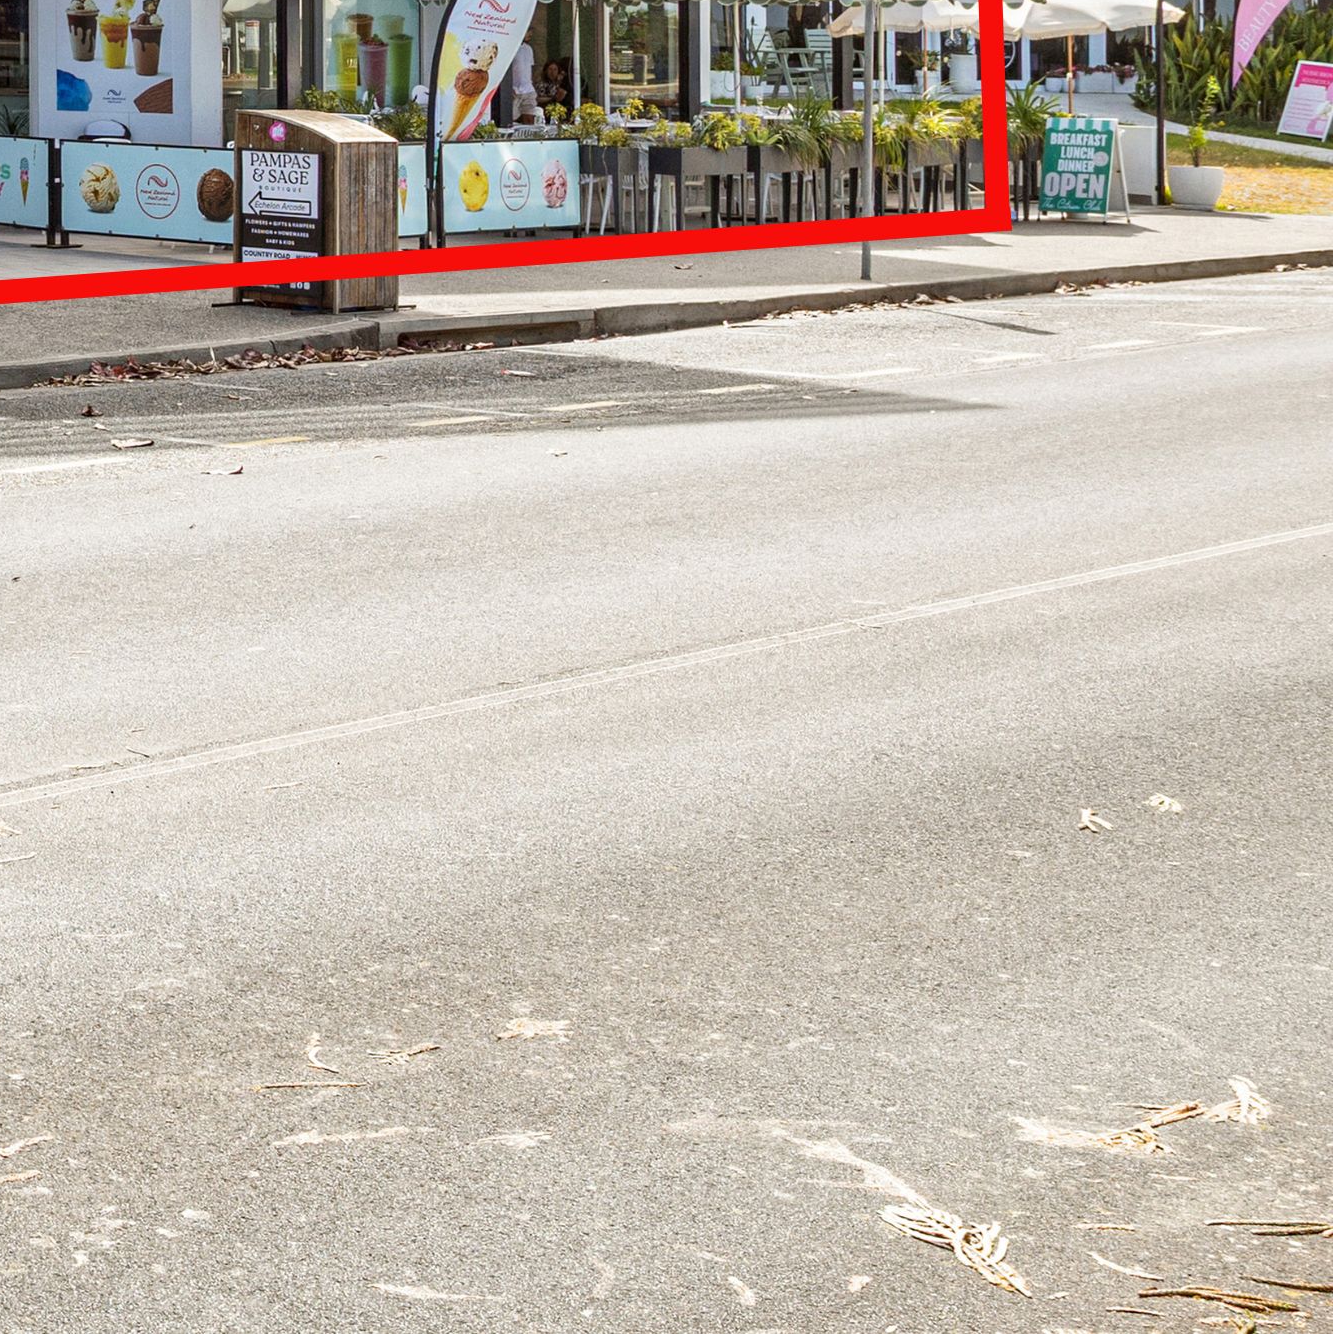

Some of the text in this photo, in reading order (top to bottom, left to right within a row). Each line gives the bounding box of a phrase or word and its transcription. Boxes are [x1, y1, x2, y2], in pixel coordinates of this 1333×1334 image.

[474, 20, 505, 29] Natural
[484, 14, 517, 24] Zealand
[1050, 132, 1107, 146] BREAKFAST
[1060, 146, 1095, 159] LUNCH
[250, 152, 311, 170] PAMPAS
[1057, 159, 1095, 173] DINNER
[252, 168, 309, 185] & SAGE
[259, 185, 302, 193] BOUTIQUE
[1044, 171, 1105, 199] OPEN
[255, 200, 306, 211] Echelon Arcade
[244, 249, 273, 258] COUNTRY
